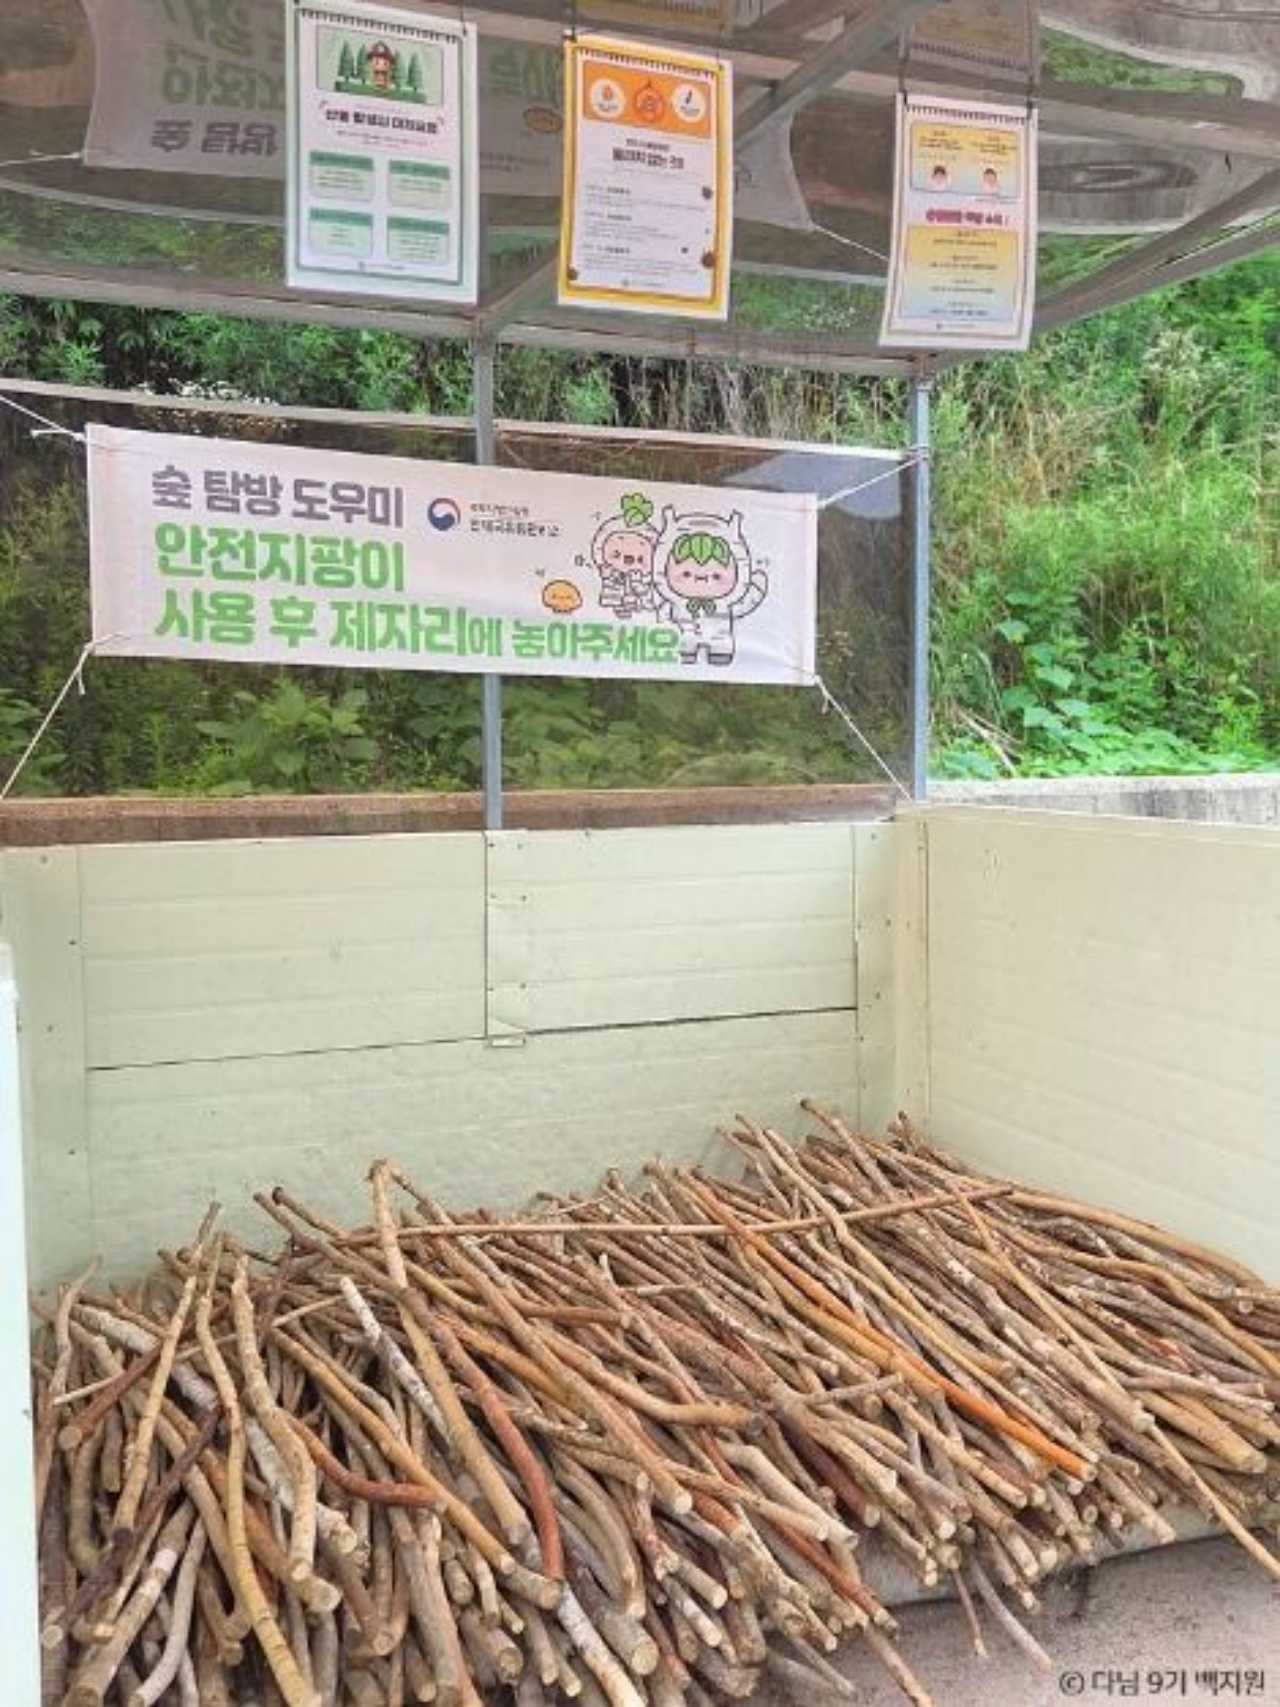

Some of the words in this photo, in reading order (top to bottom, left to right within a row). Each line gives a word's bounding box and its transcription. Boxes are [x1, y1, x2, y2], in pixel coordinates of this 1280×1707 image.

[152, 464, 192, 510] 숲
[204, 470, 284, 517] 탐방
[293, 479, 404, 528] 도우미
[154, 522, 405, 592] 안전지팡이
[154, 588, 256, 647] 사용
[269, 596, 318, 648] 후
[329, 601, 502, 657] 제자리에
[512, 619, 680, 664] 놓아주세요
